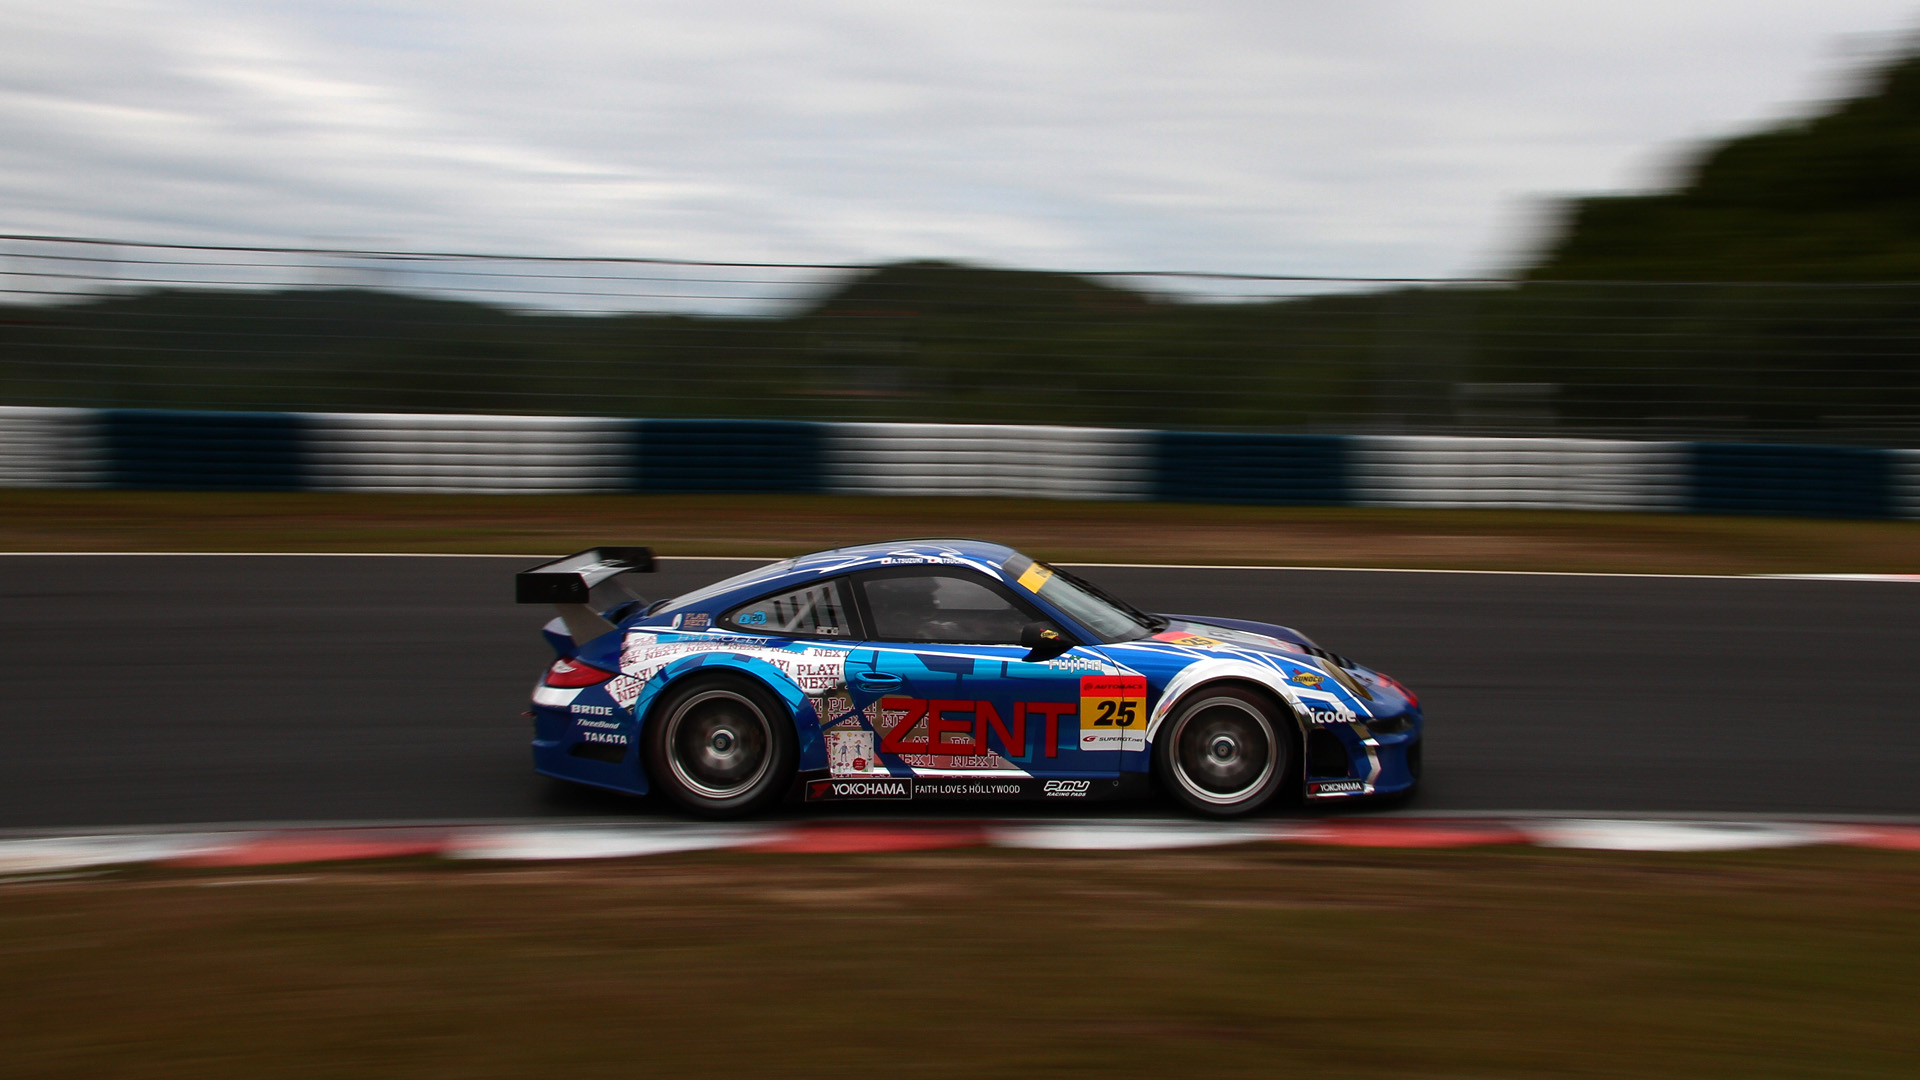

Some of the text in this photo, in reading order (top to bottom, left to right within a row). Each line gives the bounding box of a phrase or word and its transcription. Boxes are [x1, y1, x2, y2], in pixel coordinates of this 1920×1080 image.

[677, 634, 768, 645] HYDROGEN
[1181, 637, 1213, 646] 25
[645, 647, 681, 661] NEXT
[813, 648, 850, 658] NEXT
[797, 663, 840, 676] PLAY!
[615, 667, 652, 691] PLAY!
[797, 676, 840, 689] NEXT
[1292, 674, 1323, 684] SUNOCO
[570, 704, 614, 716] BRIDE
[1093, 700, 1138, 727] 25
[1310, 706, 1357, 724] icode
[576, 718, 621, 730] ThreeBond
[881, 698, 1077, 758] ZENT
[583, 731, 628, 745] TAKATA
[899, 754, 938, 767] EXT
[831, 783, 906, 796] YOKOHAMA
[915, 784, 938, 794] FAITH
[940, 784, 967, 794] LOVES
[1320, 781, 1362, 792] YOKOHAMA
